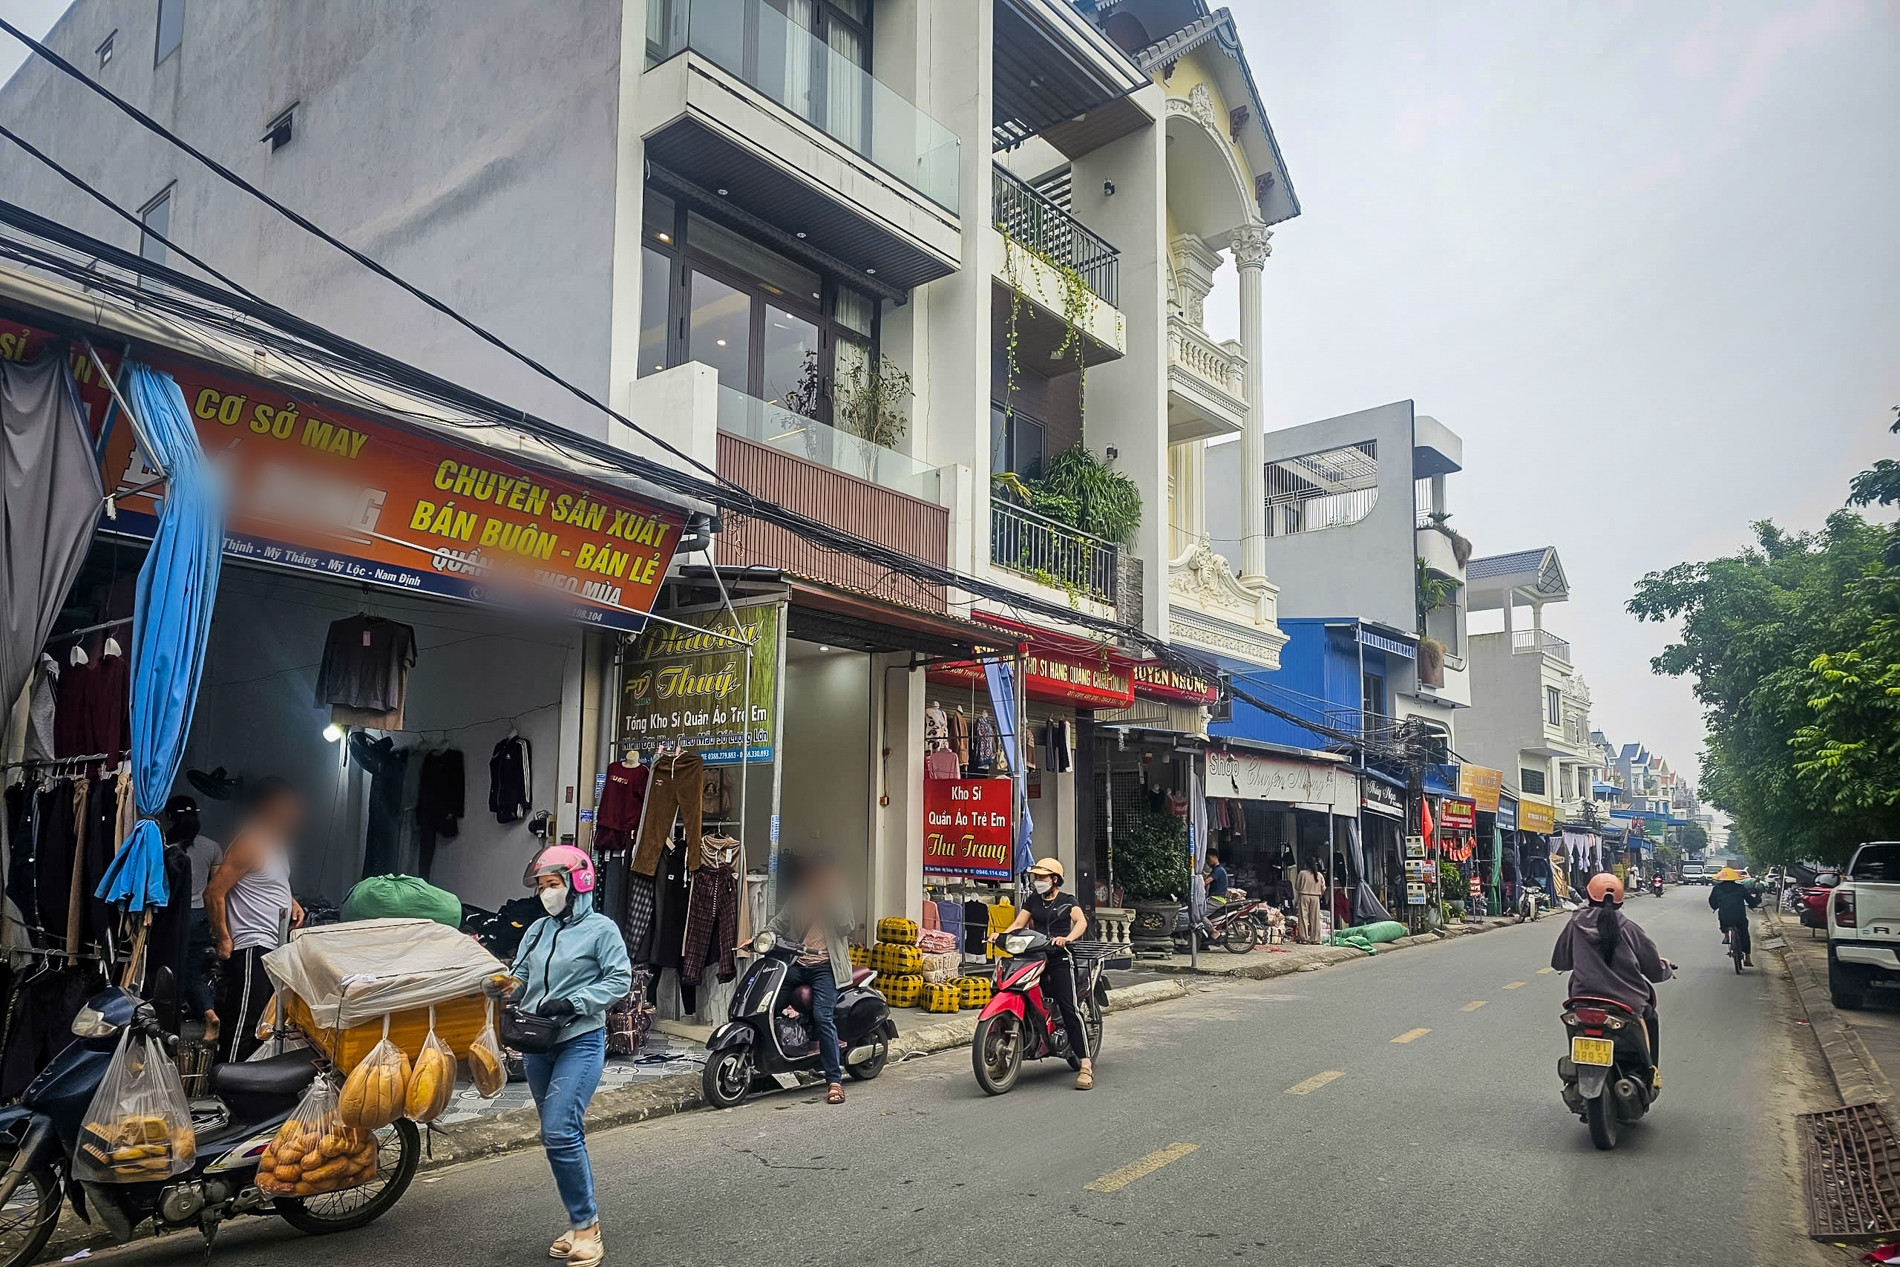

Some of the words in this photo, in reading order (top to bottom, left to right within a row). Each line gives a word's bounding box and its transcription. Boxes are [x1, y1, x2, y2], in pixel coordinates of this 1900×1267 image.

[194, 388, 249, 427] CƠ
[250, 401, 301, 441] SỞ
[300, 418, 370, 460] MAY
[434, 460, 550, 516] CHUYÊN
[550, 491, 607, 532] SẢN
[606, 511, 671, 549] XUẤT
[410, 500, 478, 542] BÁN
[479, 518, 558, 561] BUÔN
[575, 542, 630, 580] BÁN
[628, 552, 662, 586] LẺ
[222, 537, 254, 554] Thịnh
[264, 546, 282, 561] Mỹ
[284, 549, 319, 568] Thắng
[327, 559, 346, 573] Mỹ
[346, 562, 366, 577] Lộc
[375, 568, 398, 583] Nam
[398, 573, 421, 587] Định
[581, 580, 622, 605] MÙA
[626, 712, 647, 733] Tổng
[650, 713, 668, 729] Kho
[684, 709, 709, 727] Quần
[712, 705, 727, 724] Áo
[752, 705, 768, 722] Em
[951, 786, 970, 800] Kho
[928, 810, 952, 826] Quần
[955, 808, 968, 826] Áo
[971, 811, 988, 827] Trẻ
[991, 812, 1006, 827] Em
[927, 833, 956, 856] Thu
[961, 834, 1007, 865] Trang
